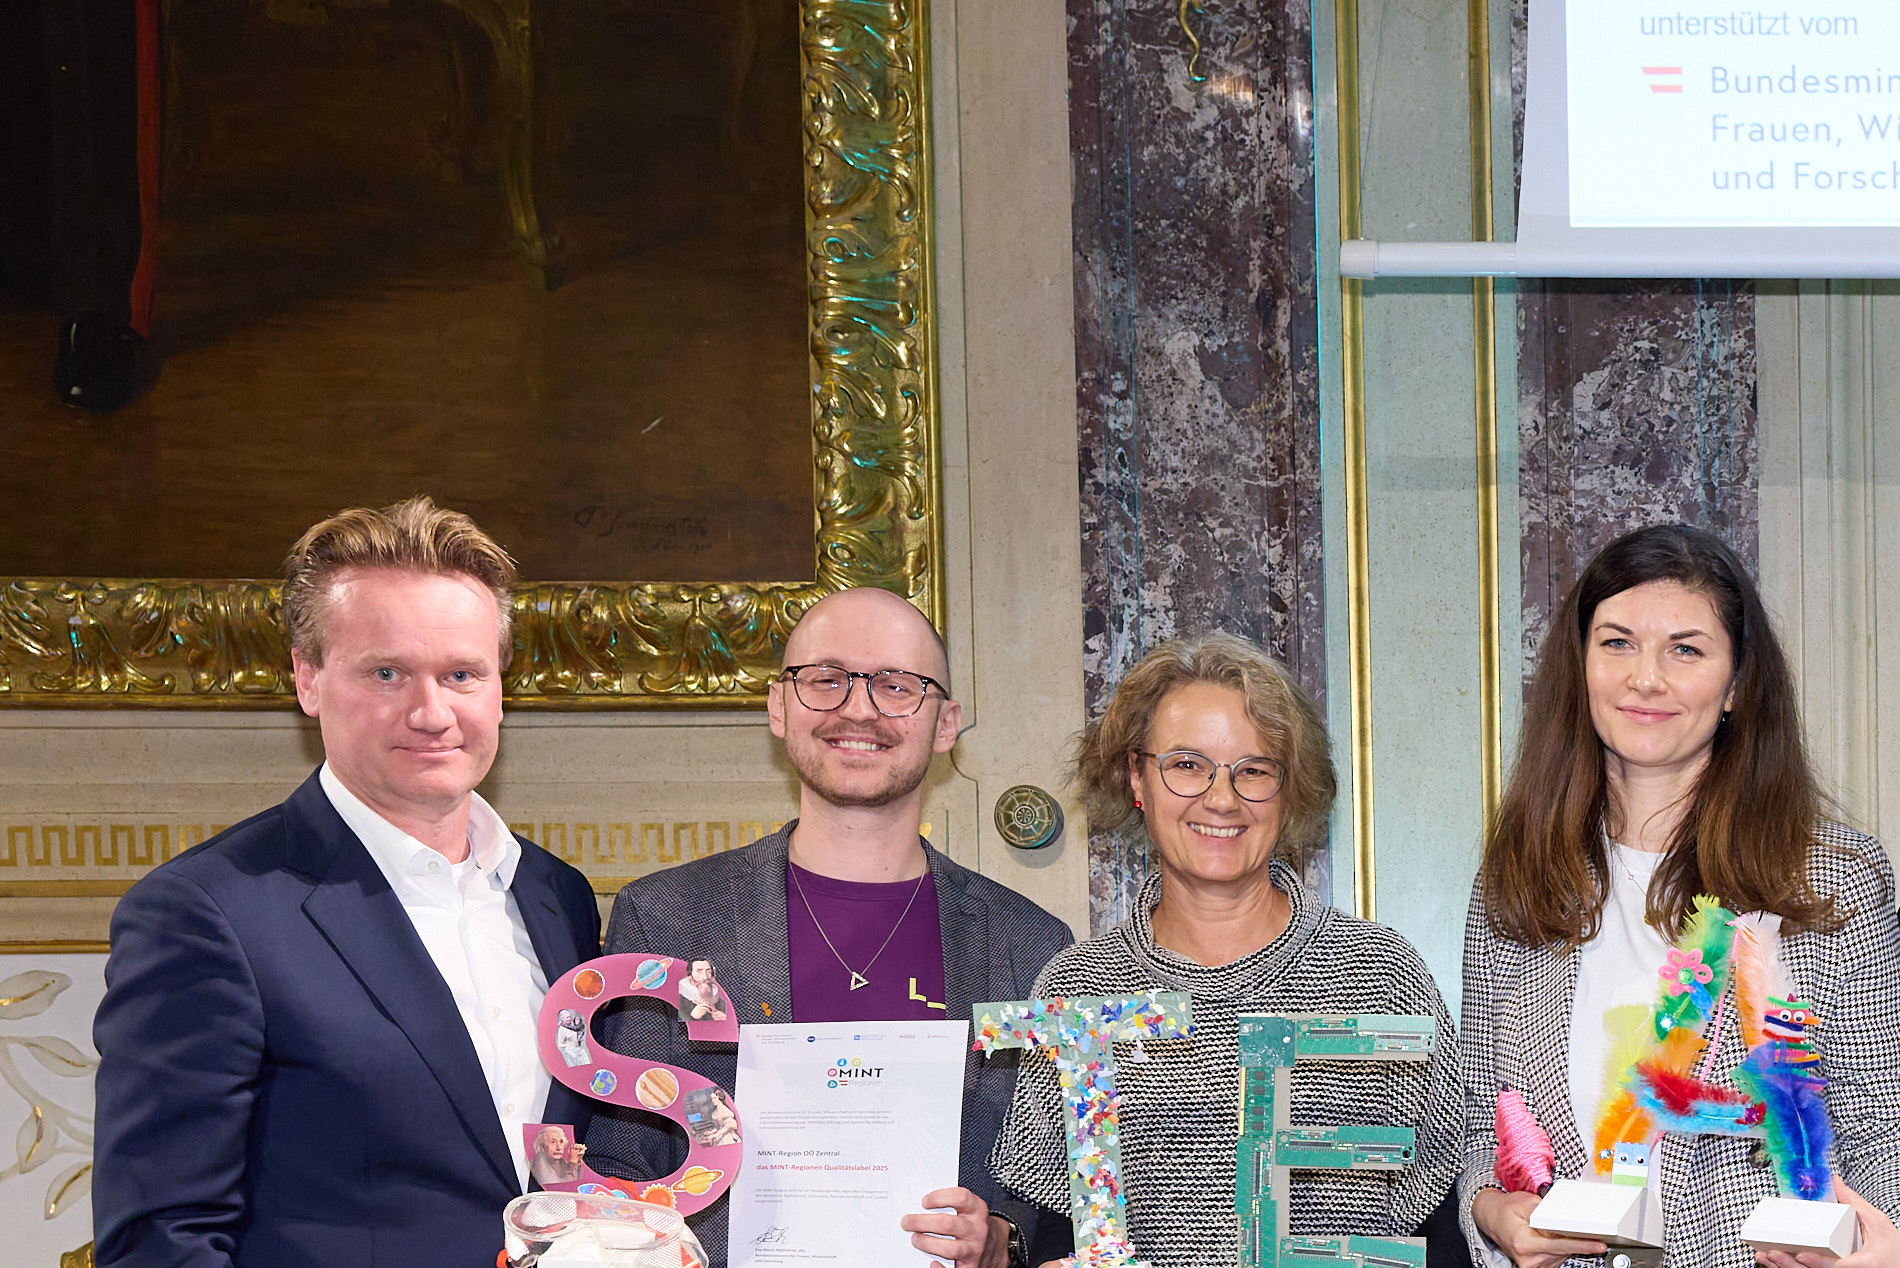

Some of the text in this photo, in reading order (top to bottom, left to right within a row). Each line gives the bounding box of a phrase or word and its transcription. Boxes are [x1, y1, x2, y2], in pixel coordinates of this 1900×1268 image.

[1639, 10, 1860, 38] unterstützt vom
[1711, 111, 1845, 150] Frauen,
[1711, 160, 1778, 193] und
[839, 1067, 884, 1079] MINT
[757, 1150, 802, 1158] MINT-Region
[815, 1149, 840, 1157] Zentral
[770, 1164, 823, 1173] MINT-Regionen
[824, 1164, 871, 1173] Qualitätslabel
[872, 1164, 889, 1172] 2025
